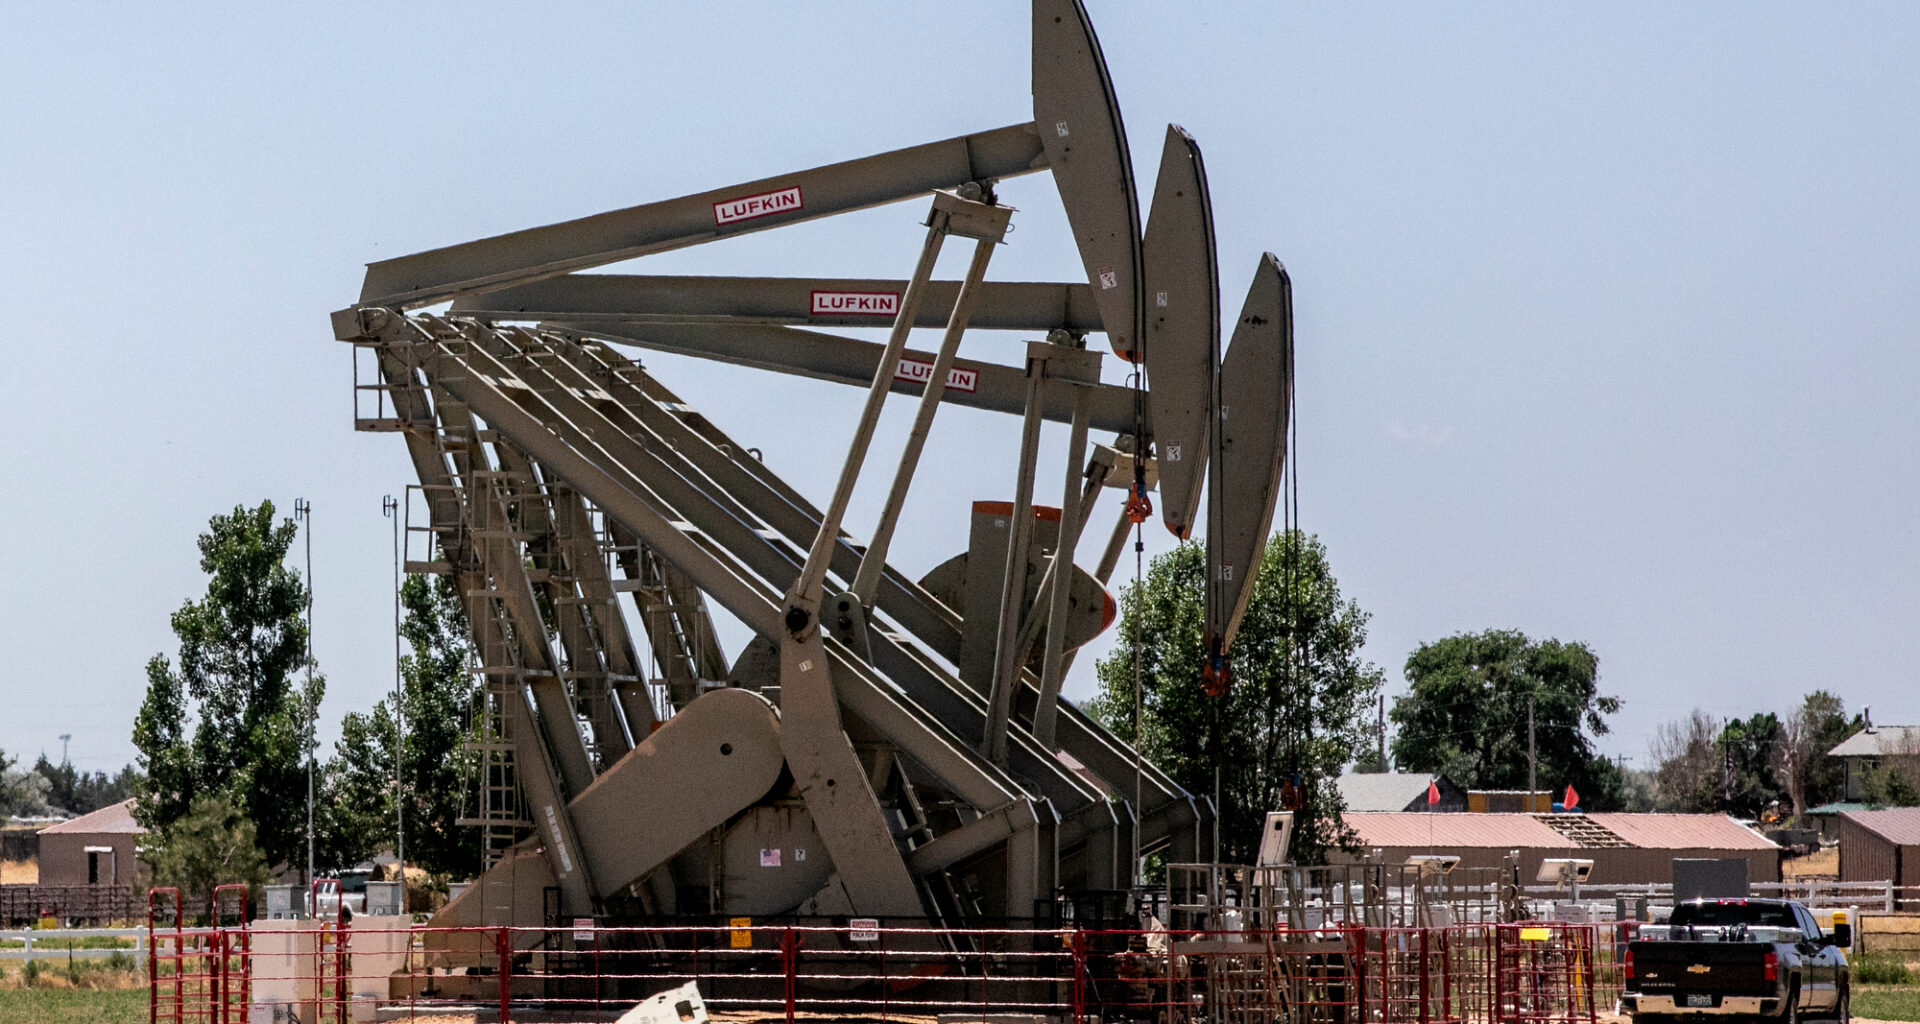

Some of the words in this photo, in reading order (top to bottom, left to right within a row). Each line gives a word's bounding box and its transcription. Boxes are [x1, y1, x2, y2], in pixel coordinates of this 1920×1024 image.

[721, 193, 795, 219] LUFKIN
[819, 297, 892, 309] LUFKIN
[900, 363, 970, 386] LUFIN
